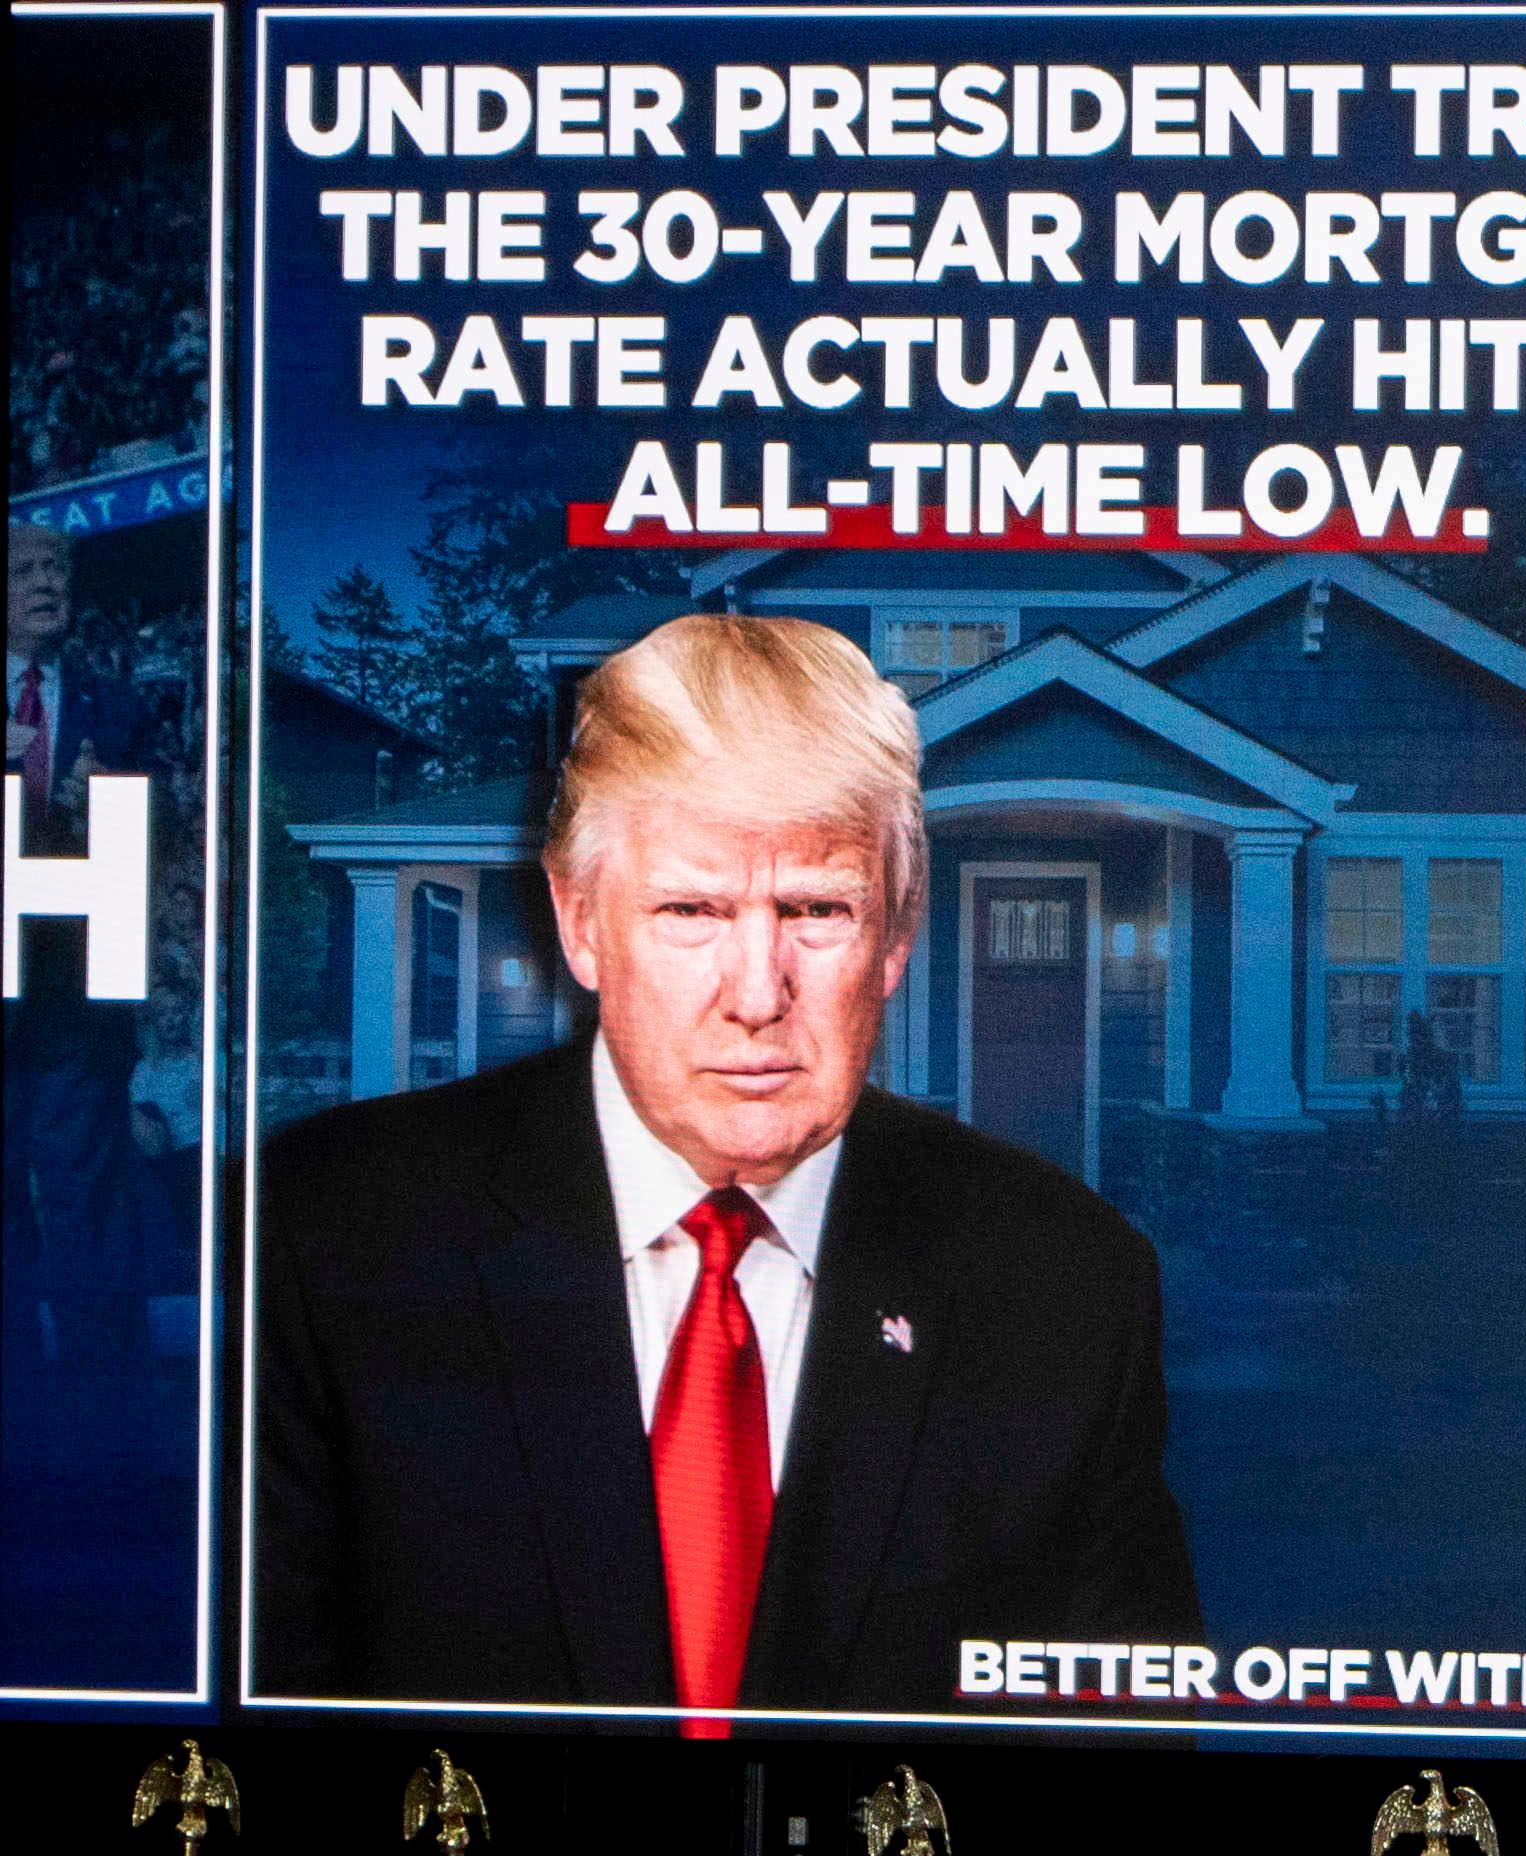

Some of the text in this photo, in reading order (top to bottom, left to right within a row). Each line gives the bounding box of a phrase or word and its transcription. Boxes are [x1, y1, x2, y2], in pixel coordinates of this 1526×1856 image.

[284, 64, 686, 158] UNDER
[714, 63, 1365, 158] PRESIDENT
[318, 189, 547, 282] THE
[572, 189, 1084, 284] 30-YEAR
[360, 314, 666, 407] RATE
[691, 314, 1326, 410] ACTUALLY
[603, 440, 1491, 539] ALL-TIME LOW.
[959, 1639, 1218, 1700] BETTER
[1232, 1645, 1372, 1703] OFF
